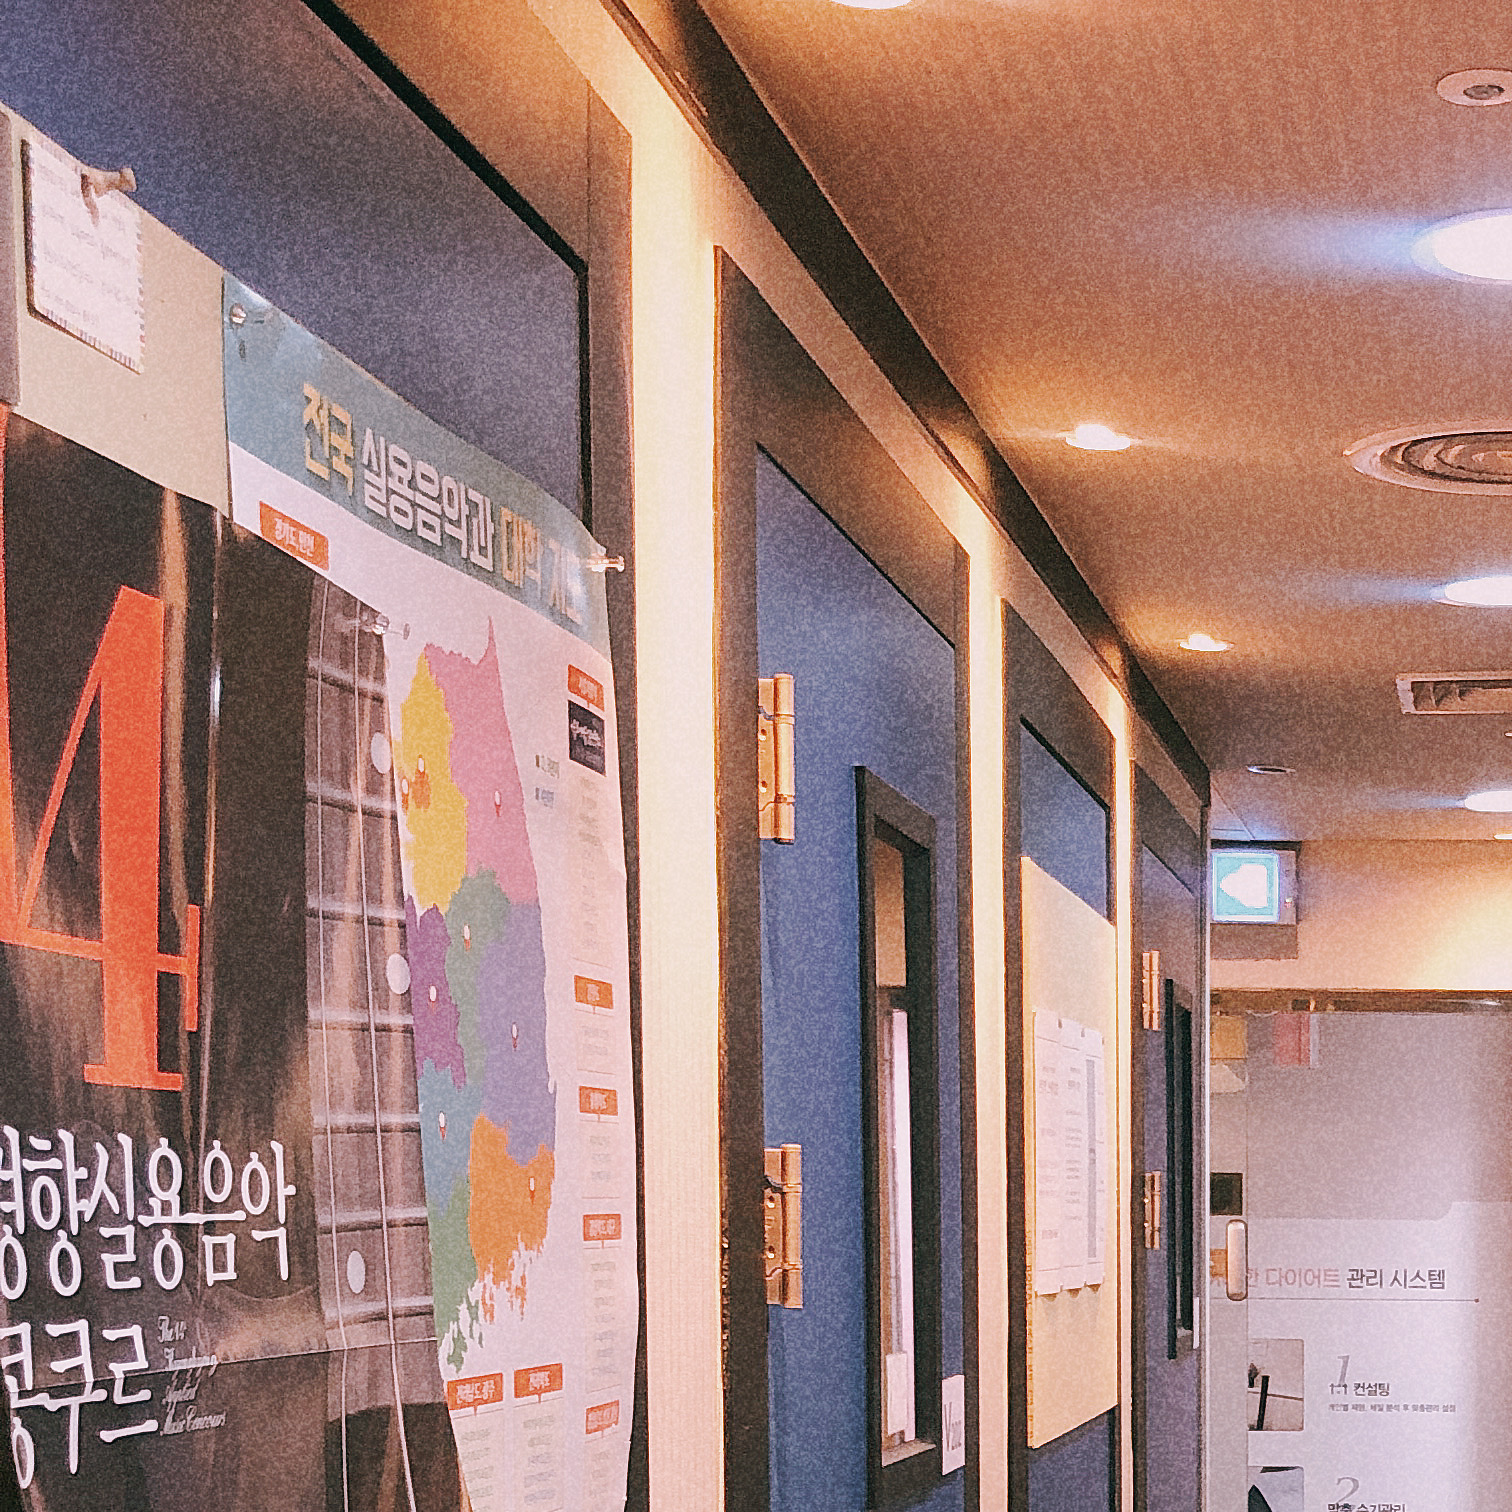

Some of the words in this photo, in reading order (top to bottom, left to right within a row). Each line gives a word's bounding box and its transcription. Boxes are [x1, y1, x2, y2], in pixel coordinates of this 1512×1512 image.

[303, 382, 354, 497] 전국
[362, 427, 494, 572] 실용음악과
[500, 505, 542, 600] 대학
[1265, 1267, 1341, 1288] 다이어트
[1346, 1267, 1383, 1289] 관리
[1390, 1268, 1446, 1290] 시스템
[1353, 1382, 1390, 1397] 컨설팅
[1336, 1476, 1359, 1509] 2
